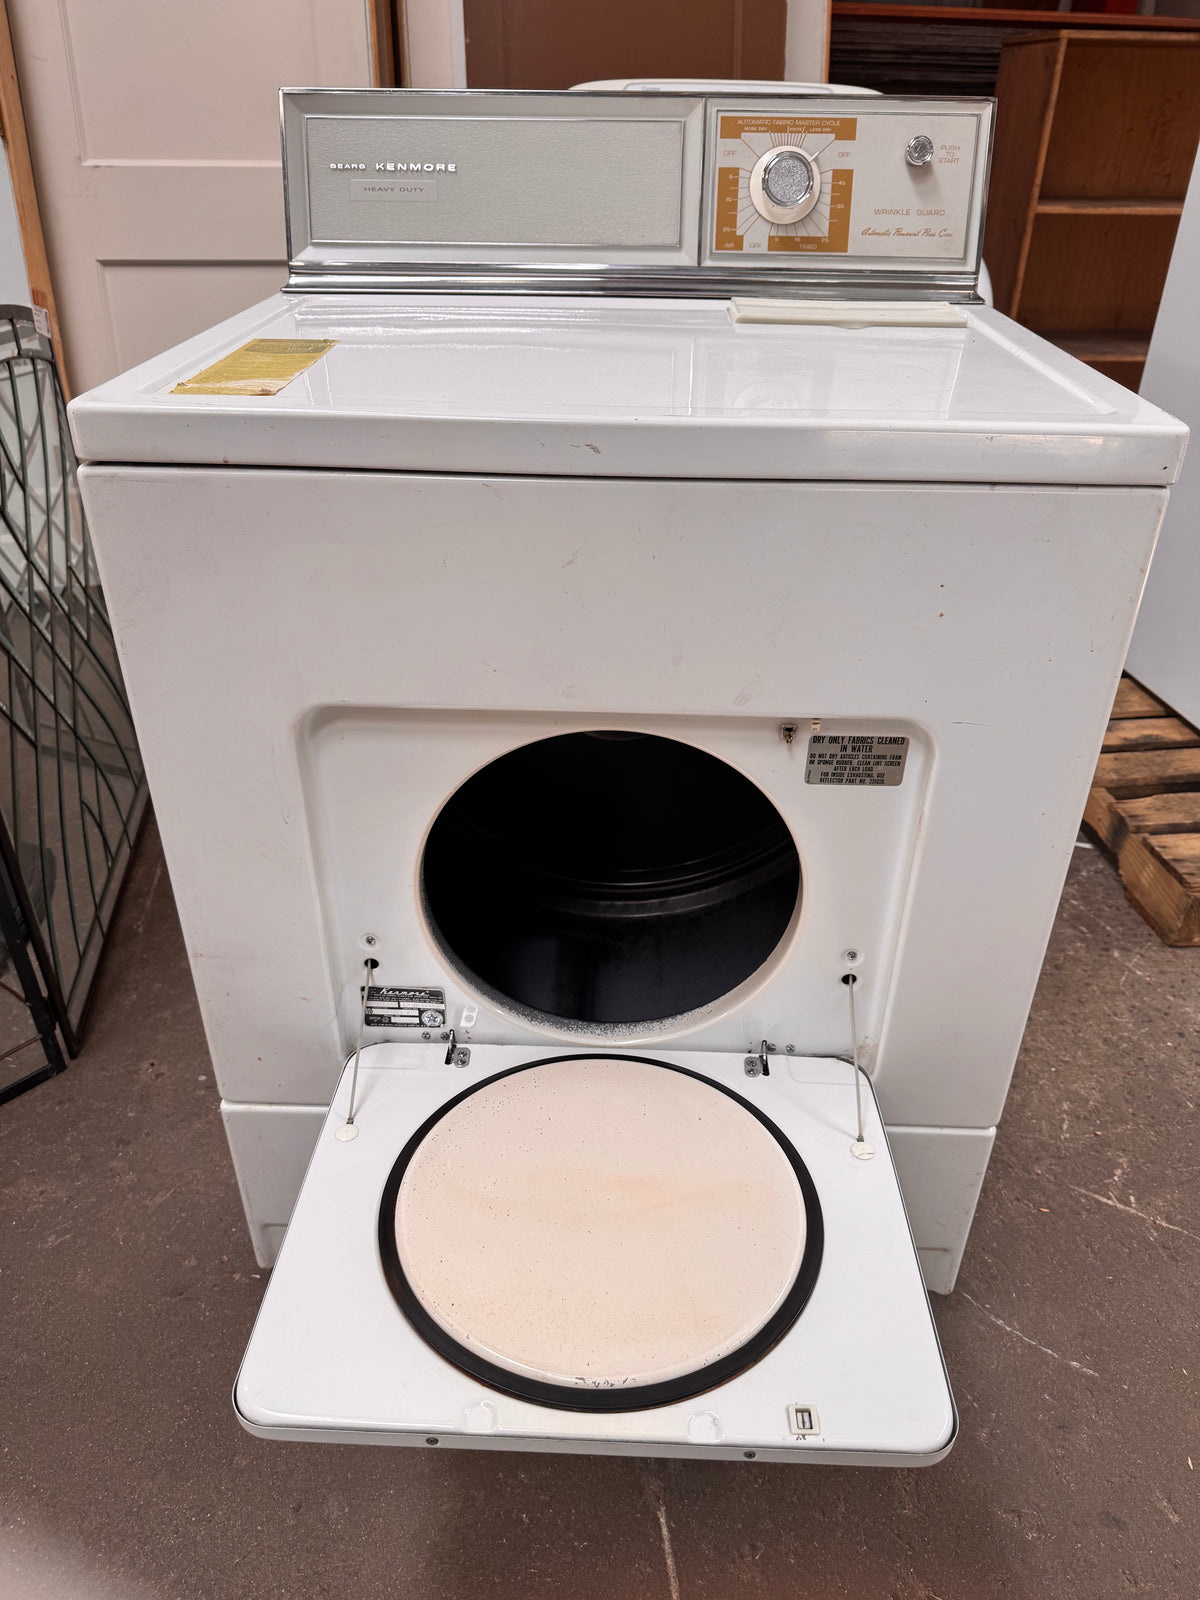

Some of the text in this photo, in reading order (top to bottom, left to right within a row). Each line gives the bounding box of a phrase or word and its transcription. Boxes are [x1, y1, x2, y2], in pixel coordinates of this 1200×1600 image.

[375, 162, 457, 172] KENMORE
[861, 227, 892, 236] Automatic
[812, 736, 905, 745] DRY ONLY FABRICS CLEANED
[851, 745, 873, 753] WATER
[380, 987, 426, 995] Kenmore
